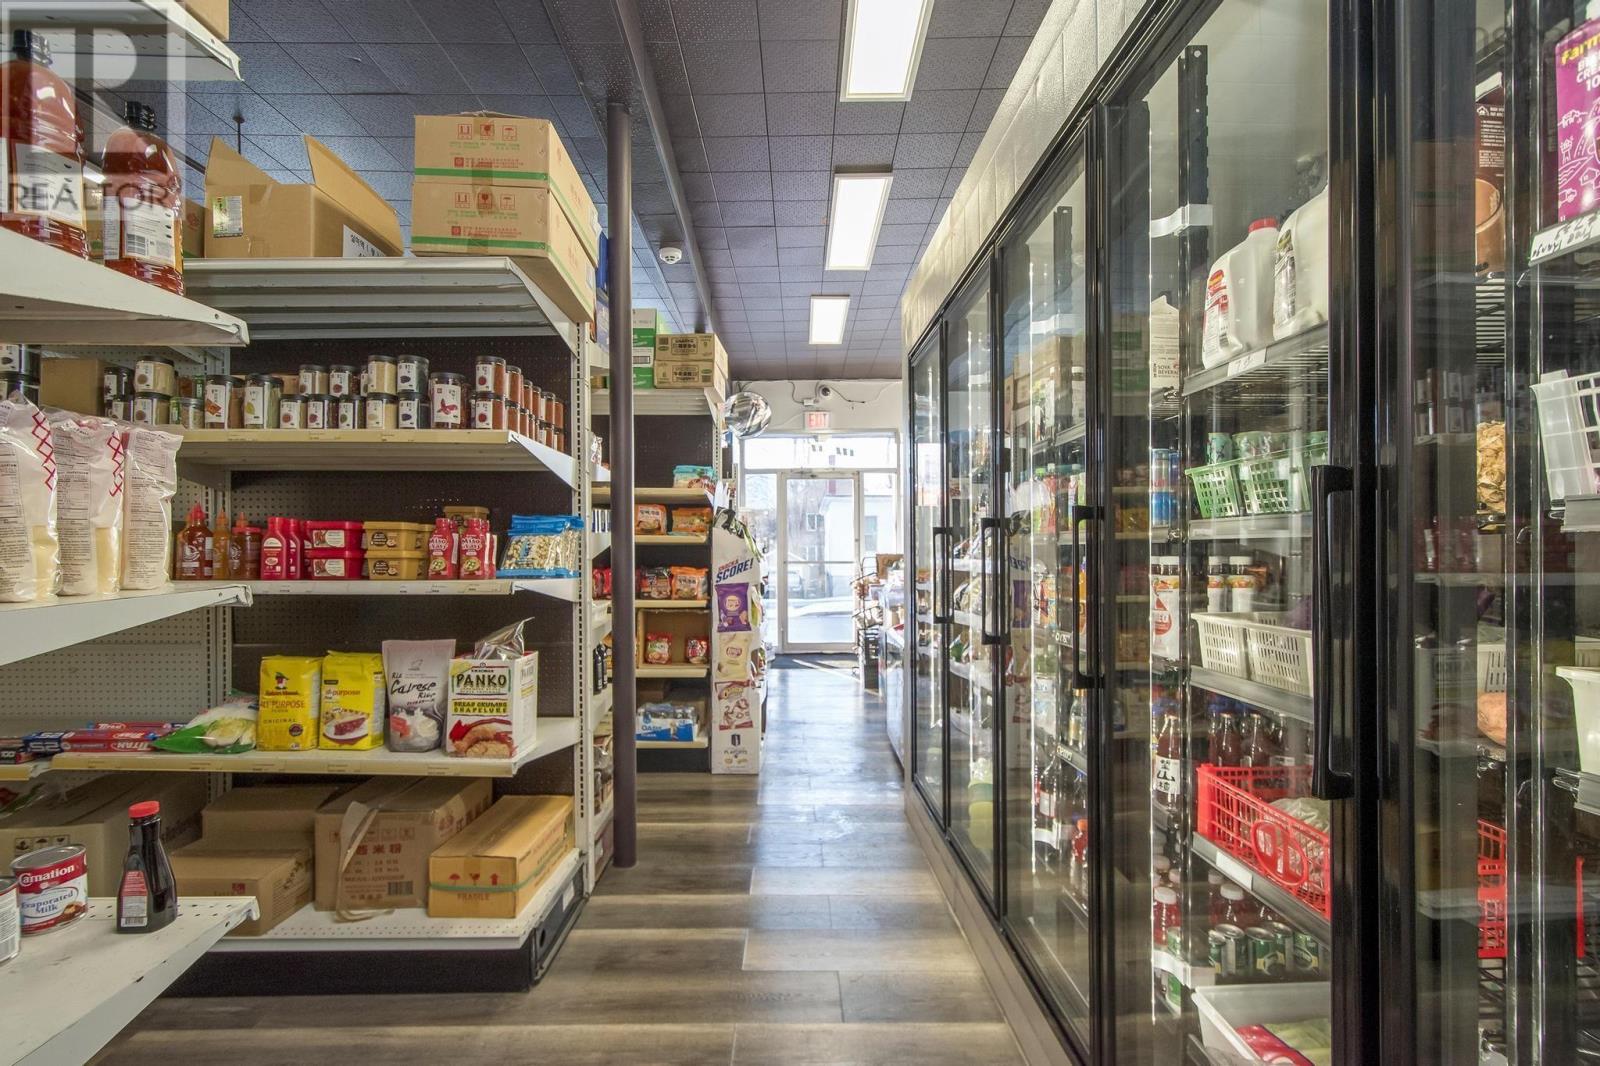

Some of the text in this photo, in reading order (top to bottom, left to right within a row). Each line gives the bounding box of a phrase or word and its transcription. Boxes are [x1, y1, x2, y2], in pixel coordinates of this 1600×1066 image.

[808, 413, 827, 427] EXIT
[716, 558, 754, 583] SCORE!
[456, 674, 507, 687] PANKO
[117, 741, 149, 751] TITAN
[18, 864, 75, 887] Carnation
[21, 890, 74, 911] Evaporated
[35, 905, 58, 914] Milk
